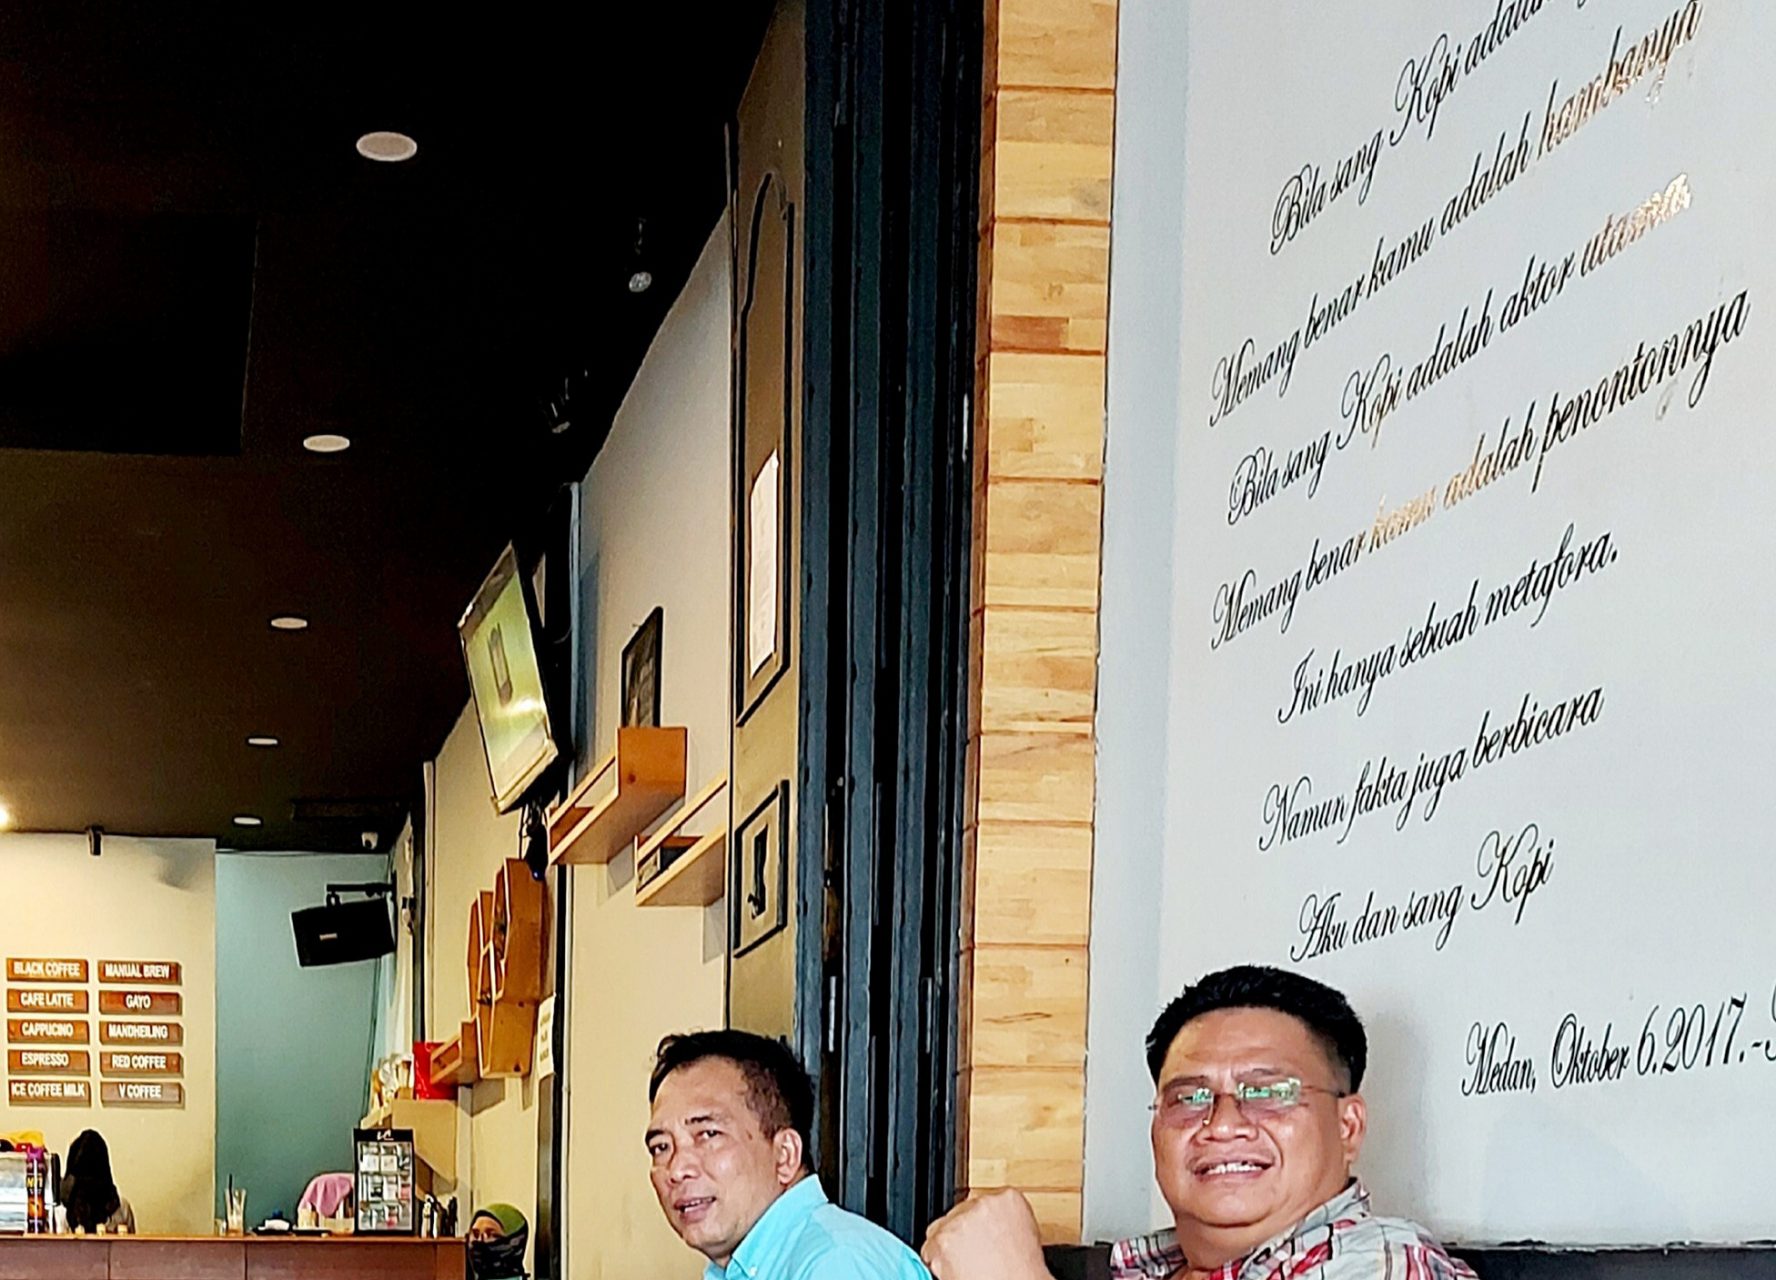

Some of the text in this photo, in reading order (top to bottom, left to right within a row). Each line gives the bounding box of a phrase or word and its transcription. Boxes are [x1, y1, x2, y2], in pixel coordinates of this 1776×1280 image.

[1270, 163, 1328, 256] Bila
[1329, 128, 1385, 207] sang
[1389, 32, 1463, 147] Kopi
[1209, 337, 1301, 427] Memang
[1303, 292, 1366, 349] benar
[1366, 216, 1437, 300] kamu
[1440, 110, 1533, 236] adalah
[1228, 446, 1280, 526] Bila
[1281, 430, 1332, 499] sang
[1336, 353, 1403, 450] Kopi
[1406, 288, 1495, 401] adalah
[1500, 251, 1576, 334] aktor
[1210, 568, 1302, 650] Memang
[1305, 530, 1367, 591] benar
[1443, 399, 1540, 510] adalah
[1531, 288, 1751, 494] penontonnya
[1278, 522, 1618, 724] Ini hanya sebuah metafora.
[1258, 686, 1605, 852] Namun fakta juga berbicara
[1289, 822, 1555, 962] Aku dan sang Kopi
[13, 961, 81, 977] BLACK COFFEE
[105, 963, 170, 979] MANUAL BREW
[20, 991, 74, 1008] CAFE LATTE
[125, 994, 151, 1009] GAYO
[21, 1052, 69, 1067] ESPRESSO
[111, 1054, 167, 1069] RED COFFEE
[1461, 1021, 1537, 1097] Medan,
[1551, 1012, 1630, 1089] Oktober
[11, 1081, 86, 1098] ICE COFFEE MILK
[126, 1084, 162, 1099] COFFEE
